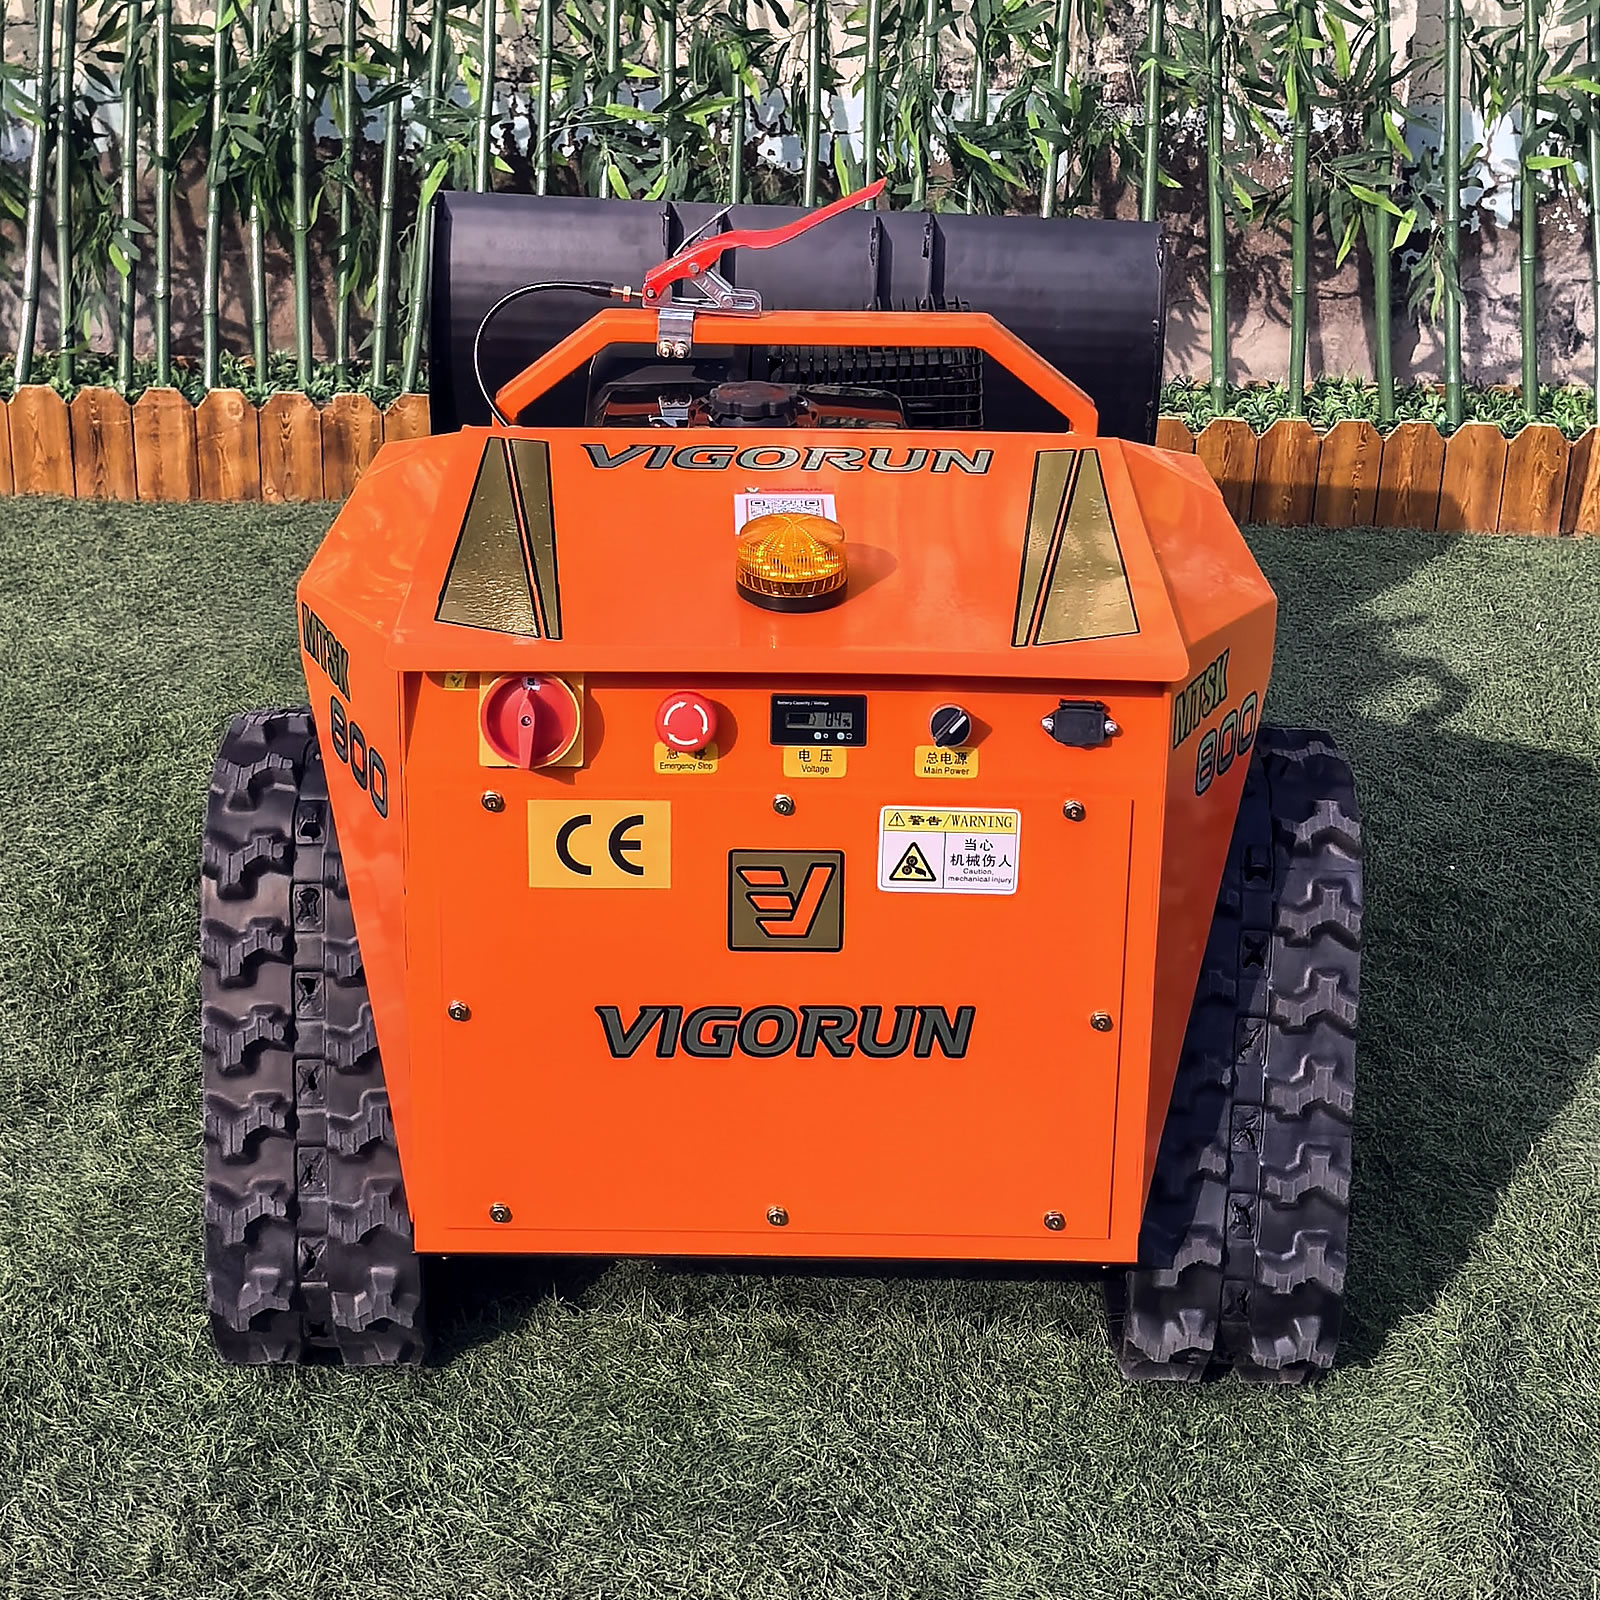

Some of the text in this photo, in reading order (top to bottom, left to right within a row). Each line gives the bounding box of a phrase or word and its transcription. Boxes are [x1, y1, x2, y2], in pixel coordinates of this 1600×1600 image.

[581, 443, 995, 475] VIGORUN
[302, 600, 351, 703] MTSK
[1173, 648, 1230, 750] MTSK
[1195, 690, 1258, 796] 800
[330, 695, 388, 819] 800
[798, 749, 833, 763] 电压
[926, 751, 968, 765] 总电源
[659, 761, 713, 771] Emergency Stop
[801, 764, 830, 775] Voltage
[923, 766, 969, 775] Main Power
[555, 813, 644, 877] CE
[964, 838, 994, 852] 当心
[950, 853, 1012, 868] 机械伤人
[948, 875, 1012, 884] mechanical injury
[594, 1004, 976, 1060] VIGORUN
